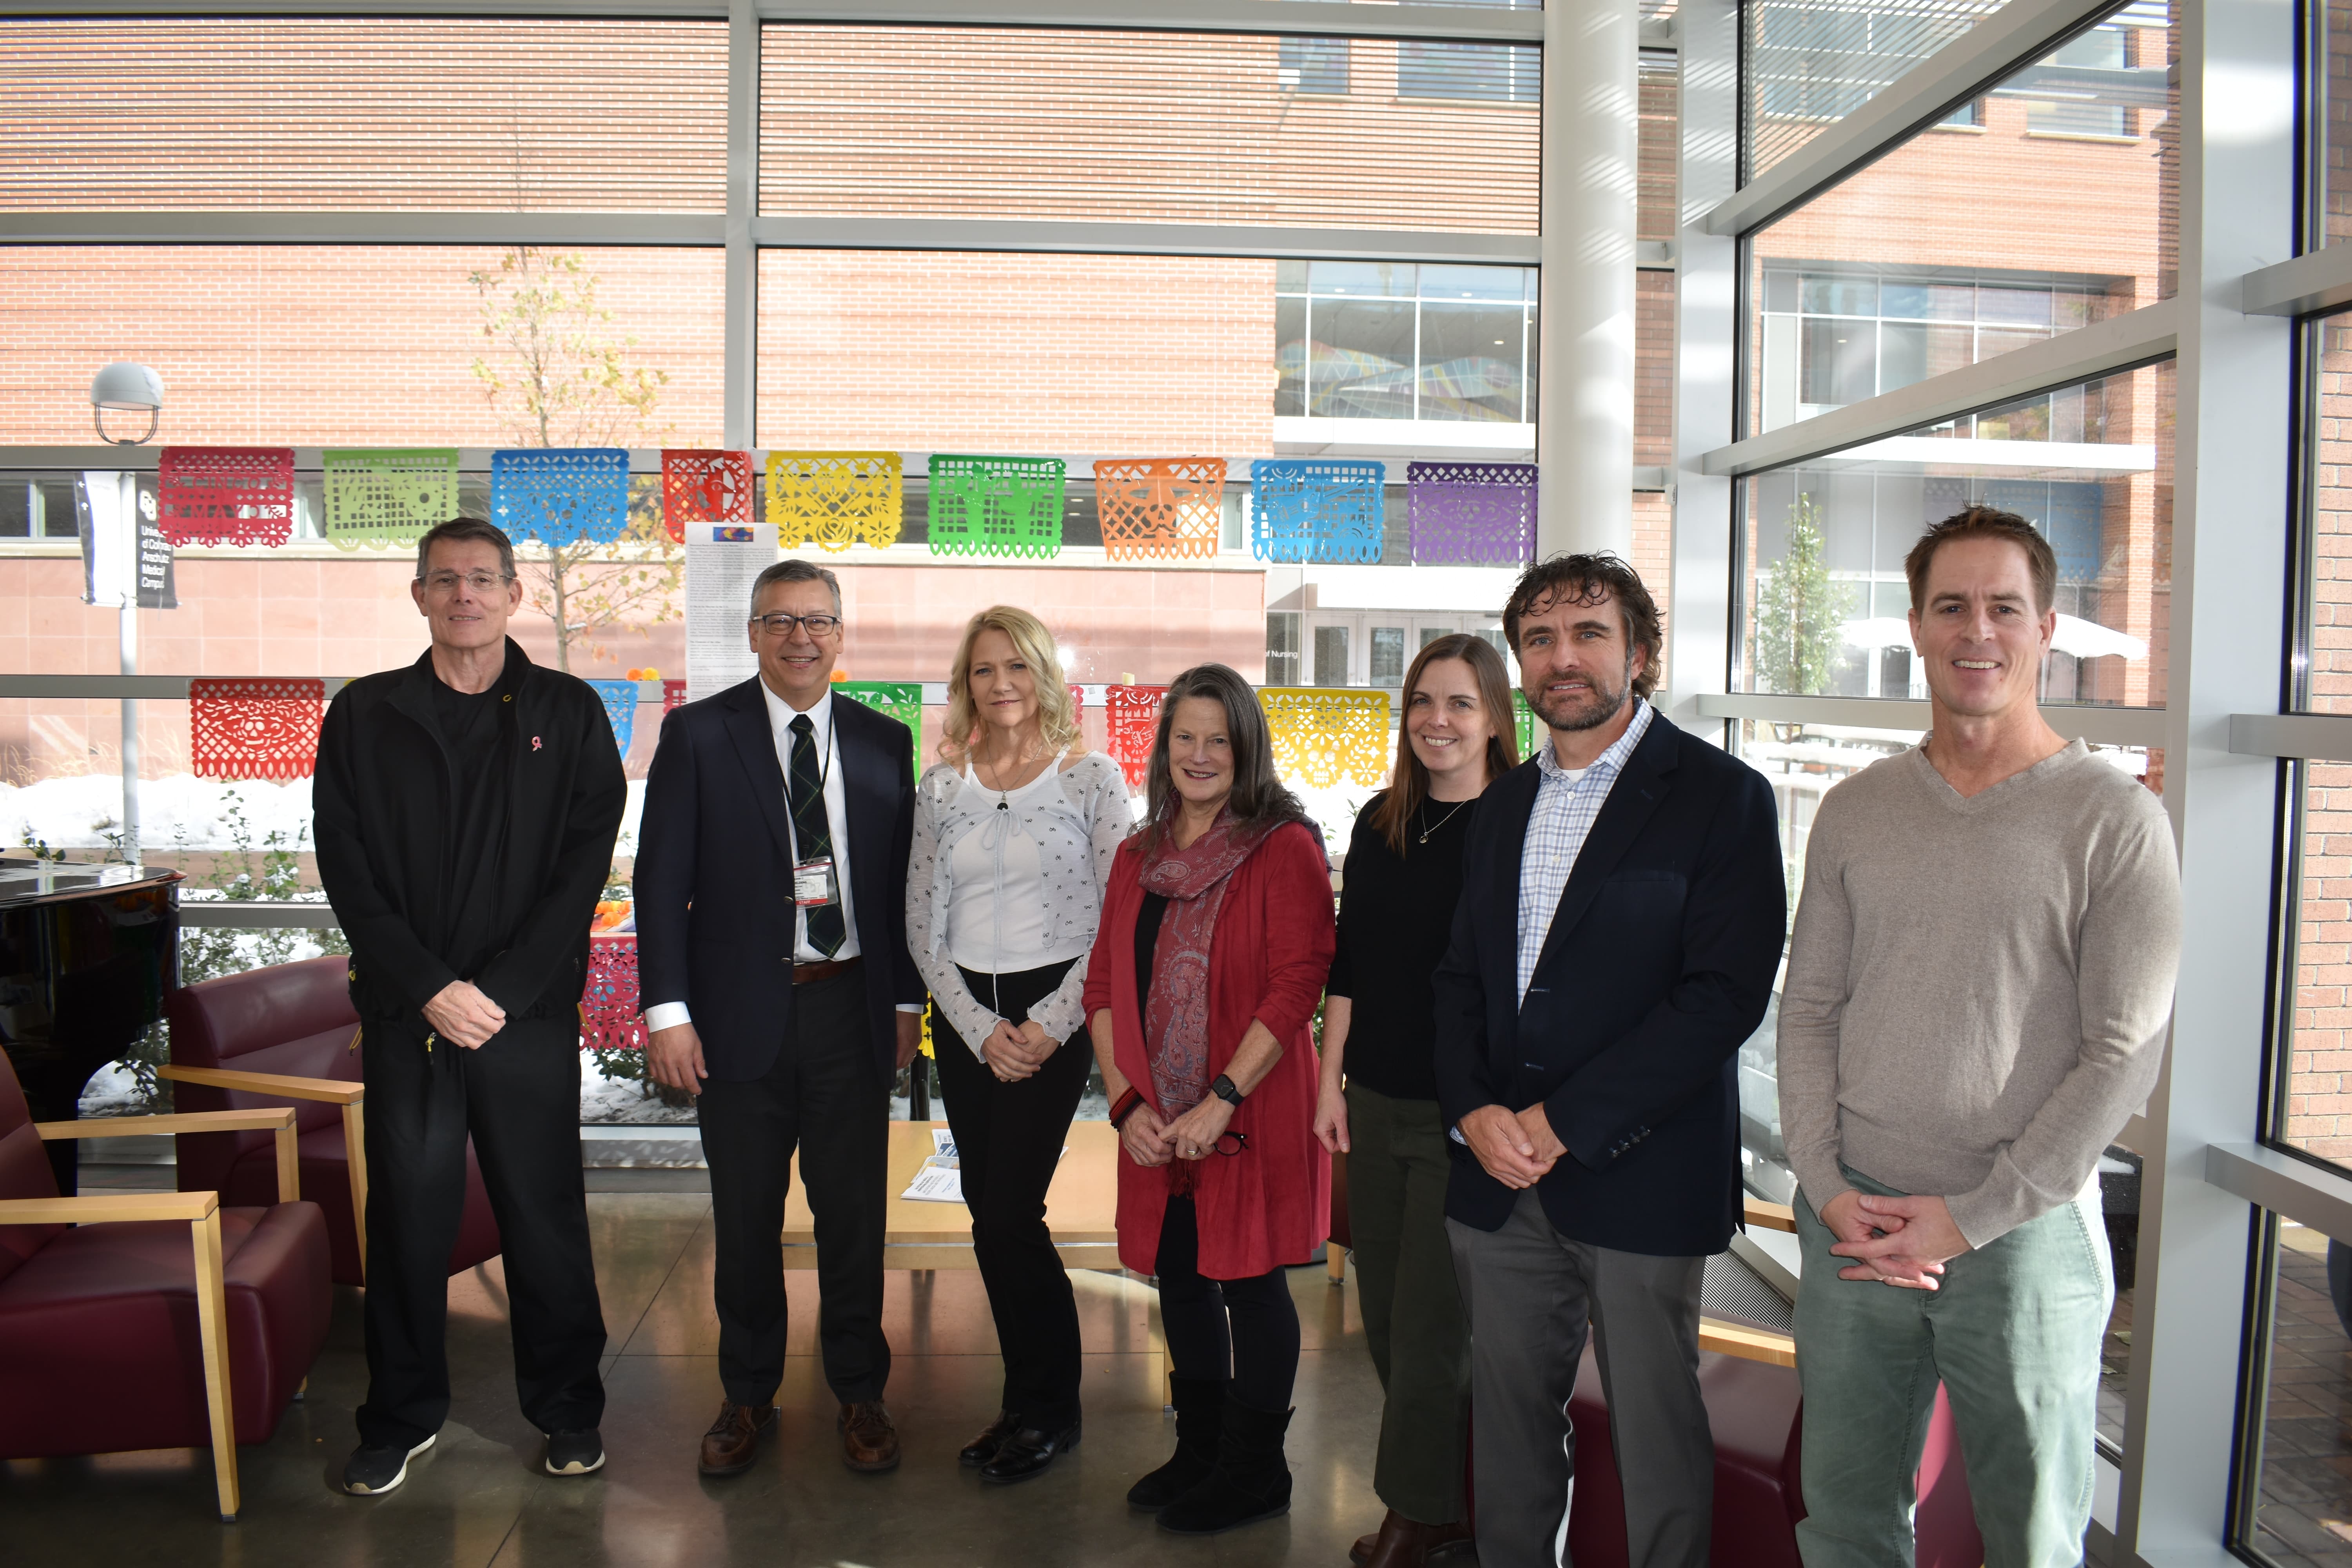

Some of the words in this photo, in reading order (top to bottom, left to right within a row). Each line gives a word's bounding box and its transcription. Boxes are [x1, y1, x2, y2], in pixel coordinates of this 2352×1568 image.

[191, 505, 260, 519] MAYO
[142, 551, 169, 564] Anschutz
[142, 564, 165, 575] Medical
[142, 577, 165, 590] Campus
[1271, 650, 1298, 659] Nursing
